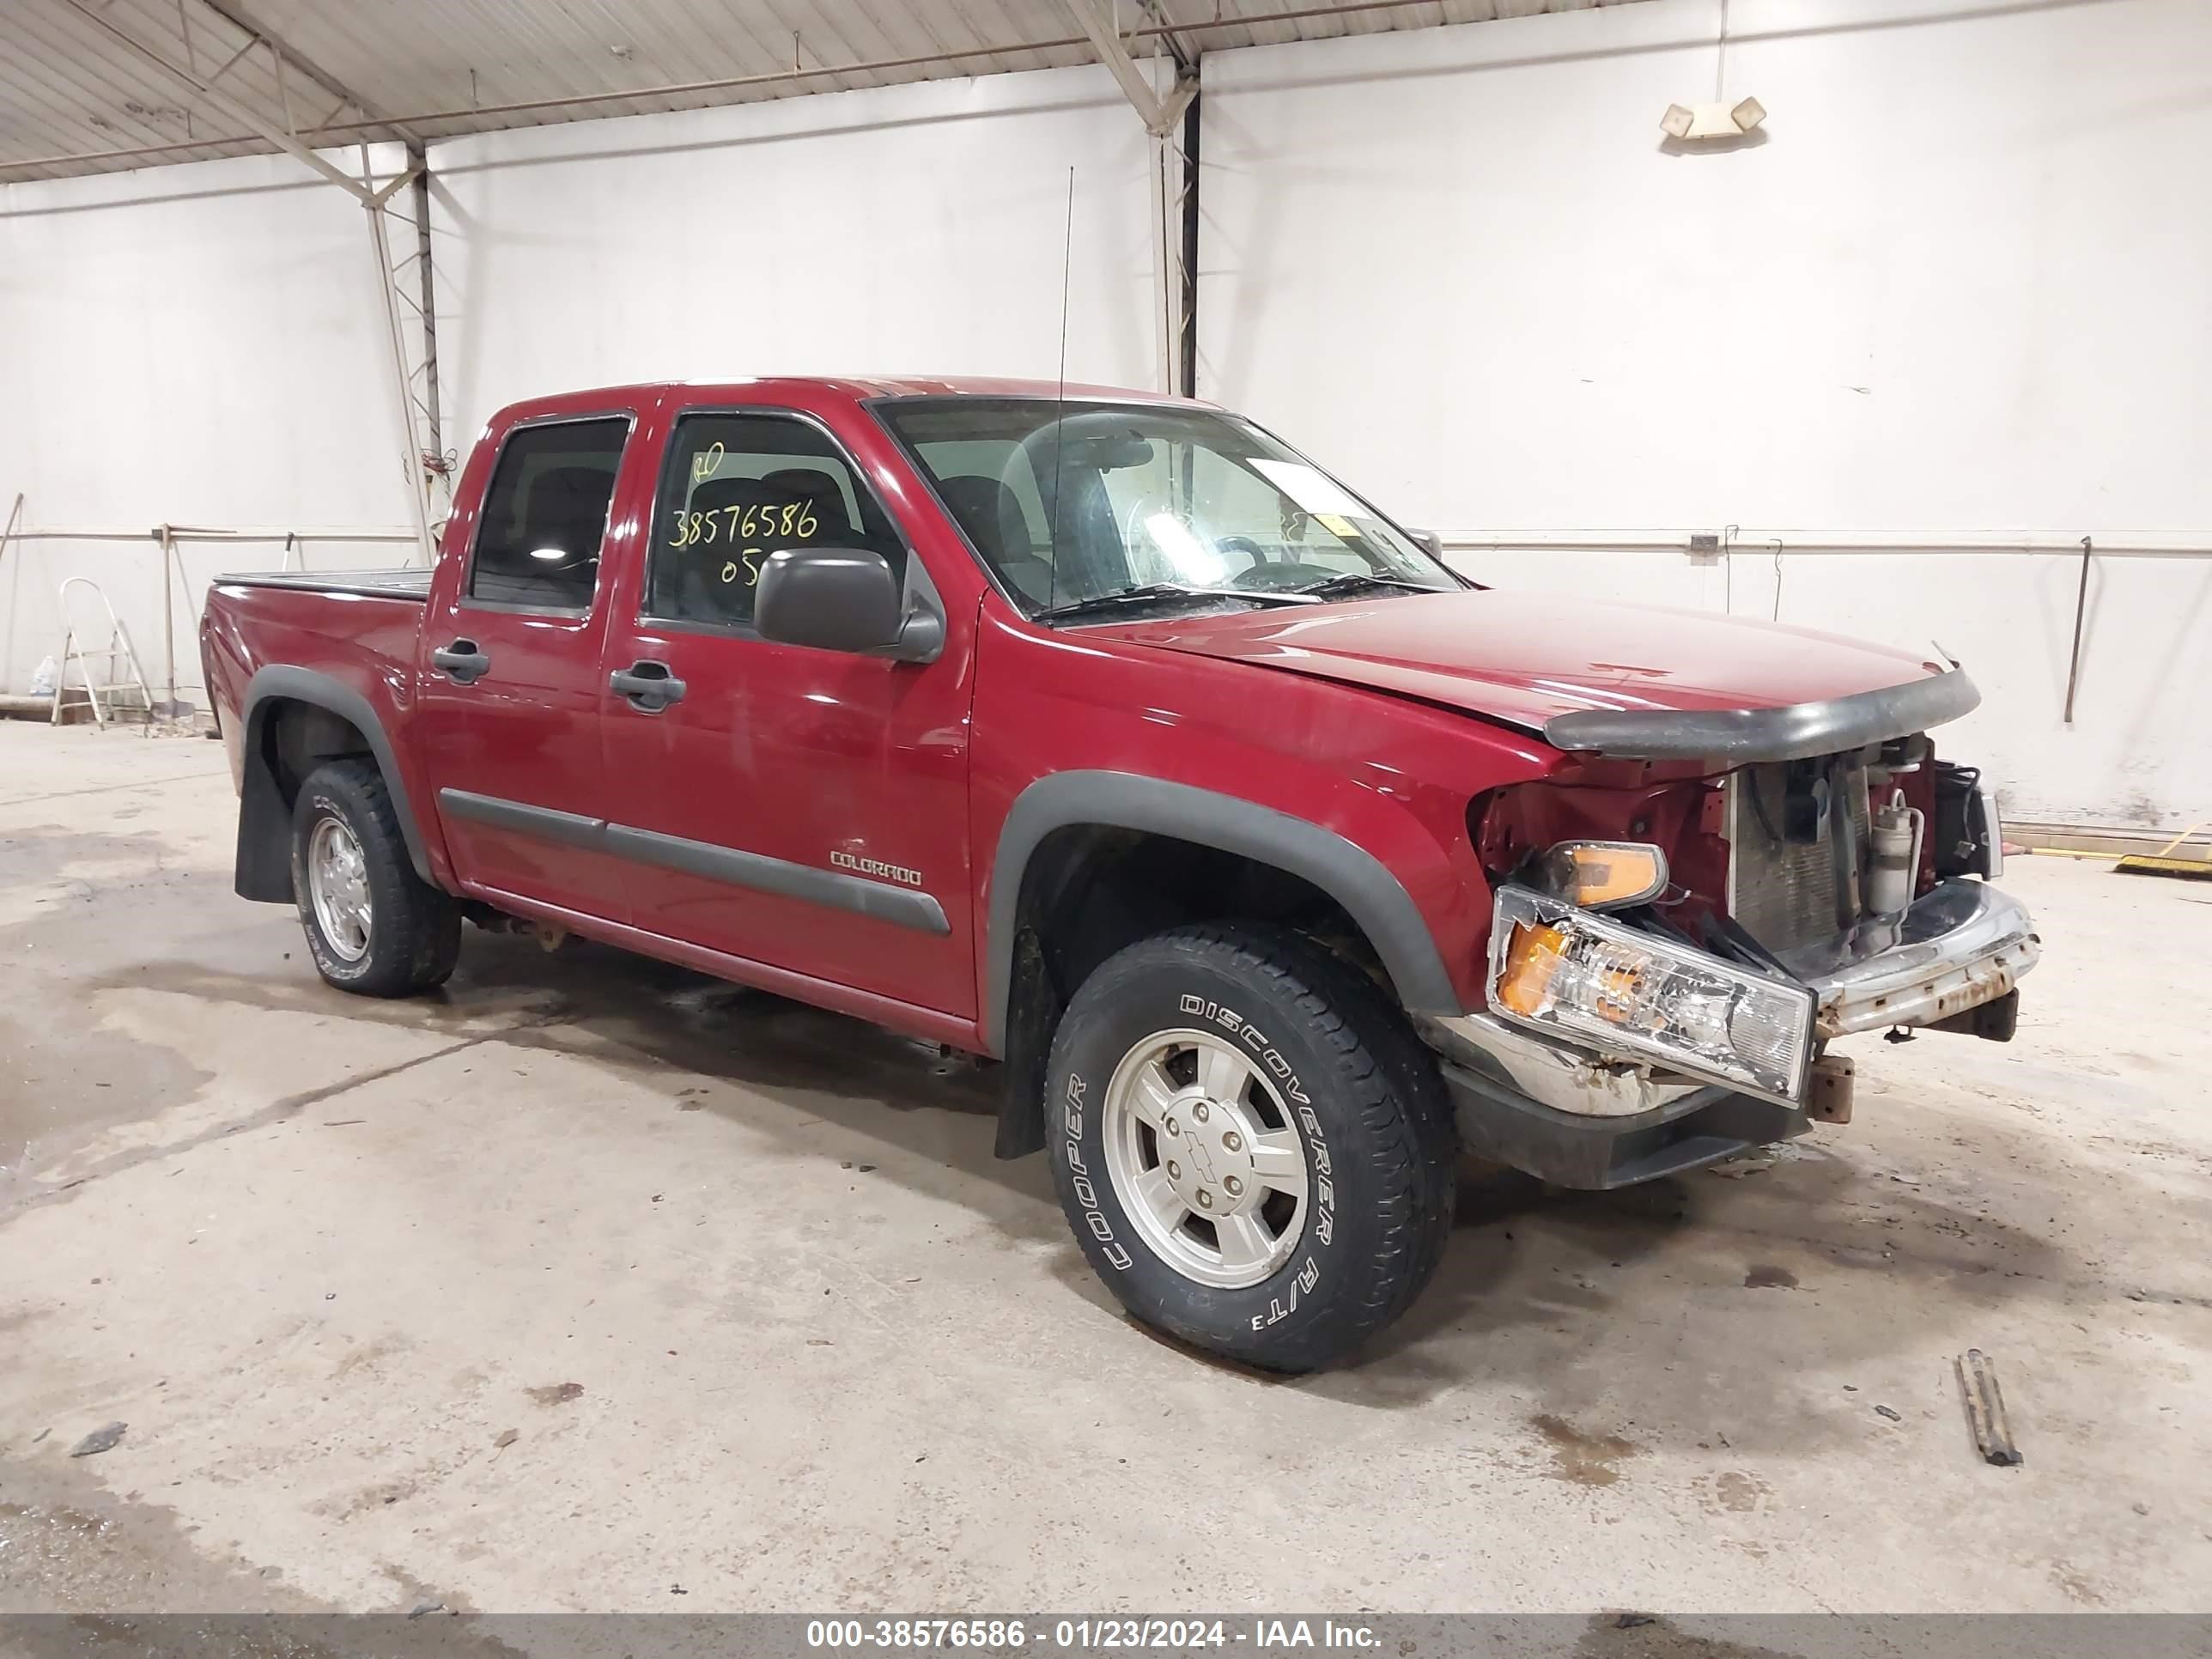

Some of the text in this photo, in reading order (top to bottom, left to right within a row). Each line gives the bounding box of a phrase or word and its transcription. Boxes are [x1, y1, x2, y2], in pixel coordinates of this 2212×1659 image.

[668, 498, 818, 547] 38576586
[830, 850, 921, 886] COLORADO
[1065, 1072, 1133, 1273] COOPER
[1179, 993, 1334, 1247] DISCOVERER
